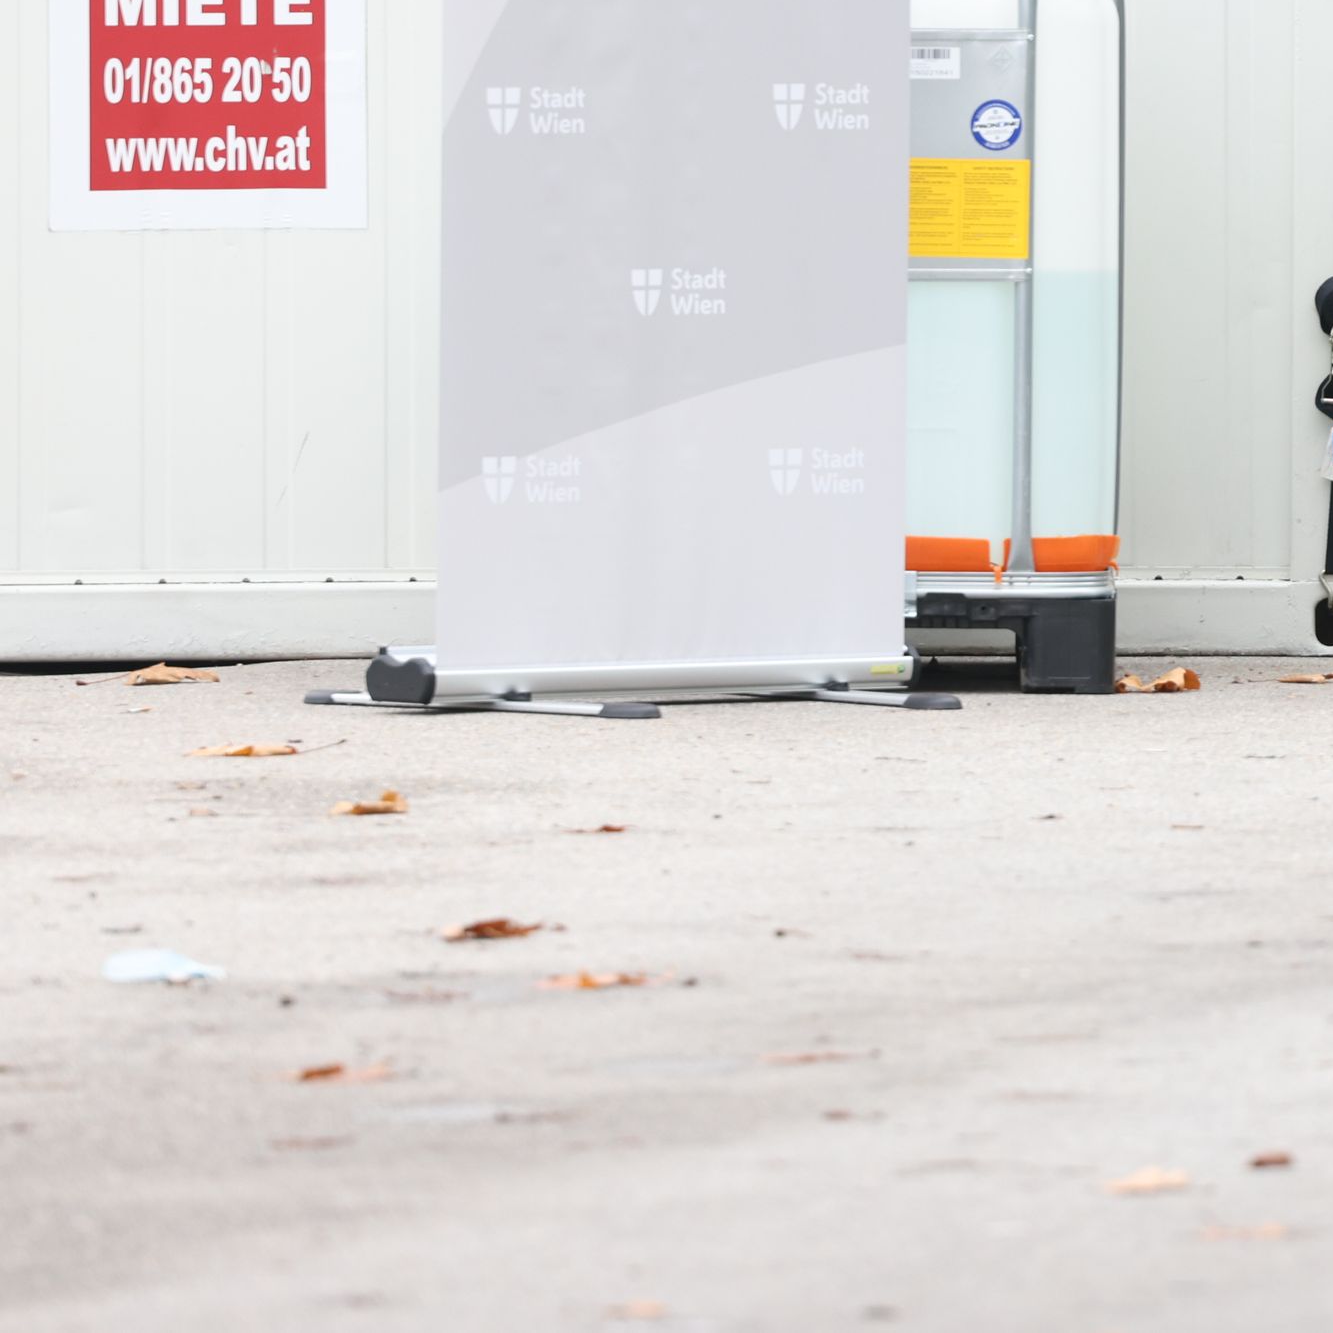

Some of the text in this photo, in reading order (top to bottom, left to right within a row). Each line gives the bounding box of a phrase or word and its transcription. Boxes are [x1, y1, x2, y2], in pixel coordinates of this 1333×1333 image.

[103, 57, 213, 104] 01/865
[530, 86, 586, 109] Stadt
[814, 82, 870, 105] Stadt
[530, 113, 586, 134] Wien
[814, 109, 870, 130] Wien
[105, 125, 311, 173] www.chv.at
[670, 268, 727, 291] Stadt
[670, 295, 727, 315] Wien
[525, 455, 582, 478] Stadt
[810, 447, 866, 470] Stadt
[525, 482, 582, 503] Wien
[810, 474, 866, 495] Wien
